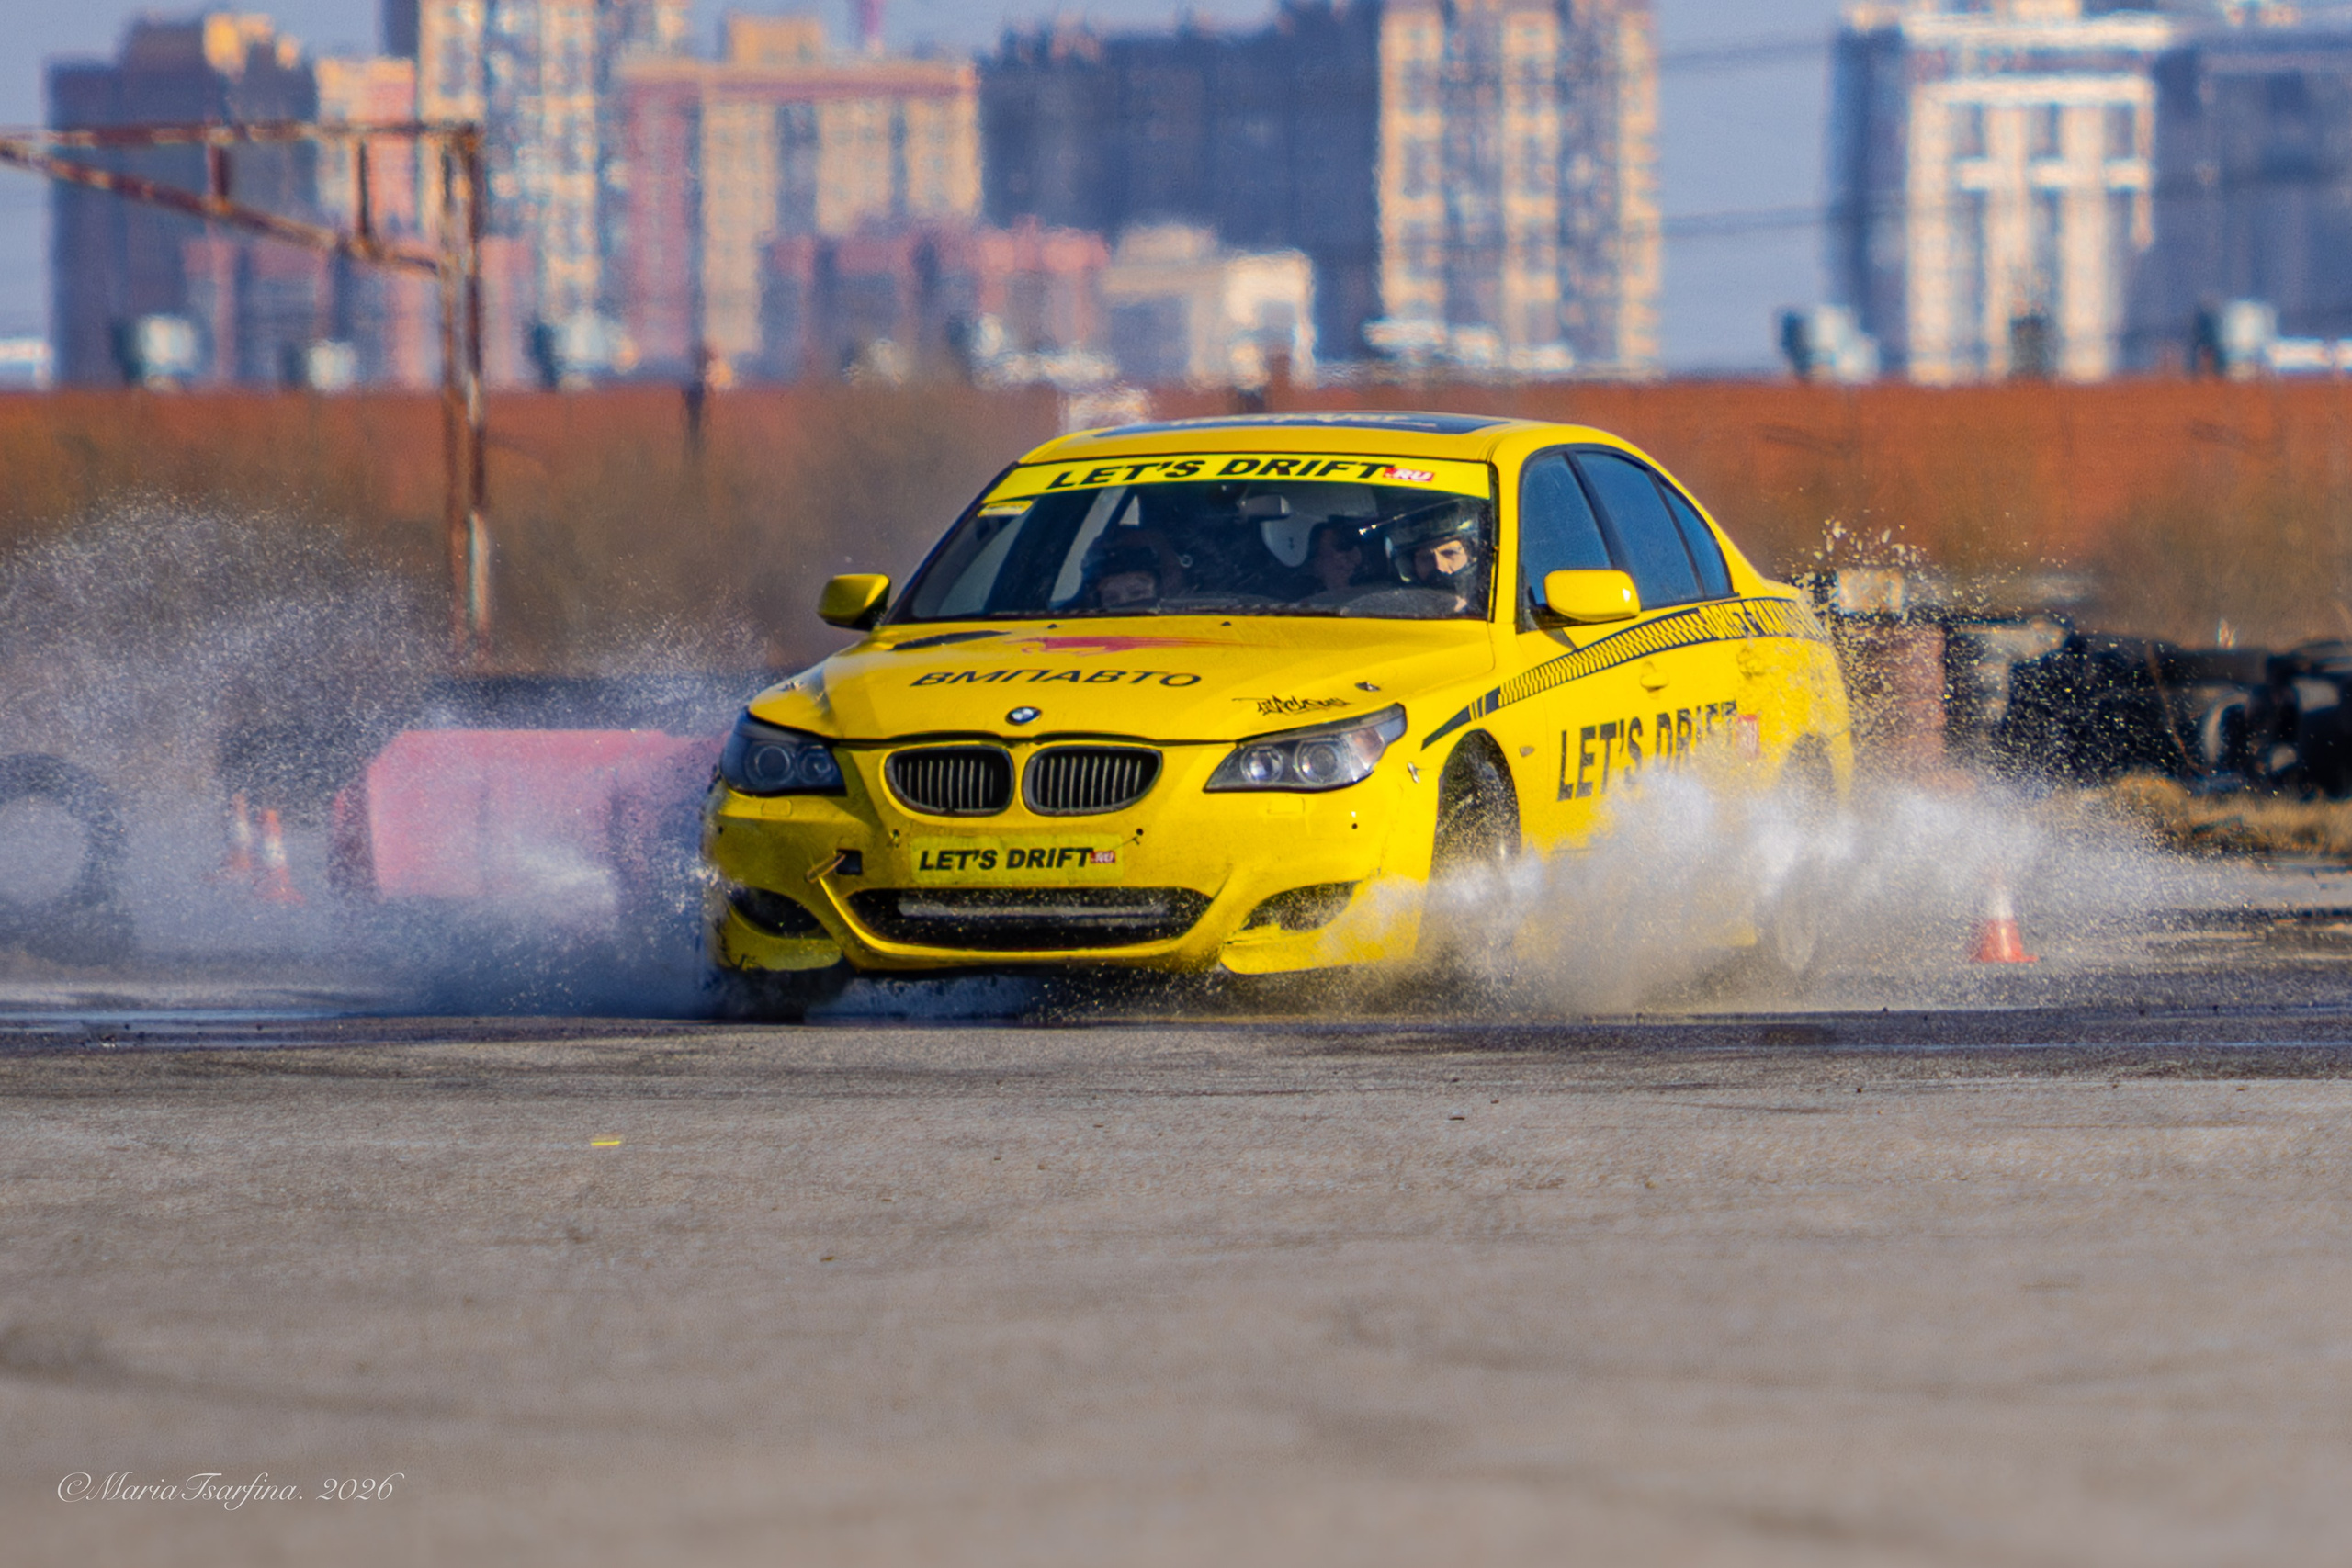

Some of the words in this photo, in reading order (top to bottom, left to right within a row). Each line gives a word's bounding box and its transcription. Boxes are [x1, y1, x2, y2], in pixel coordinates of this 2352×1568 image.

[1046, 458, 1205, 490] LET'S
[909, 669, 1202, 687] ВМПАВТО
[1556, 716, 1644, 803] LET'S
[920, 849, 998, 871] LET'S
